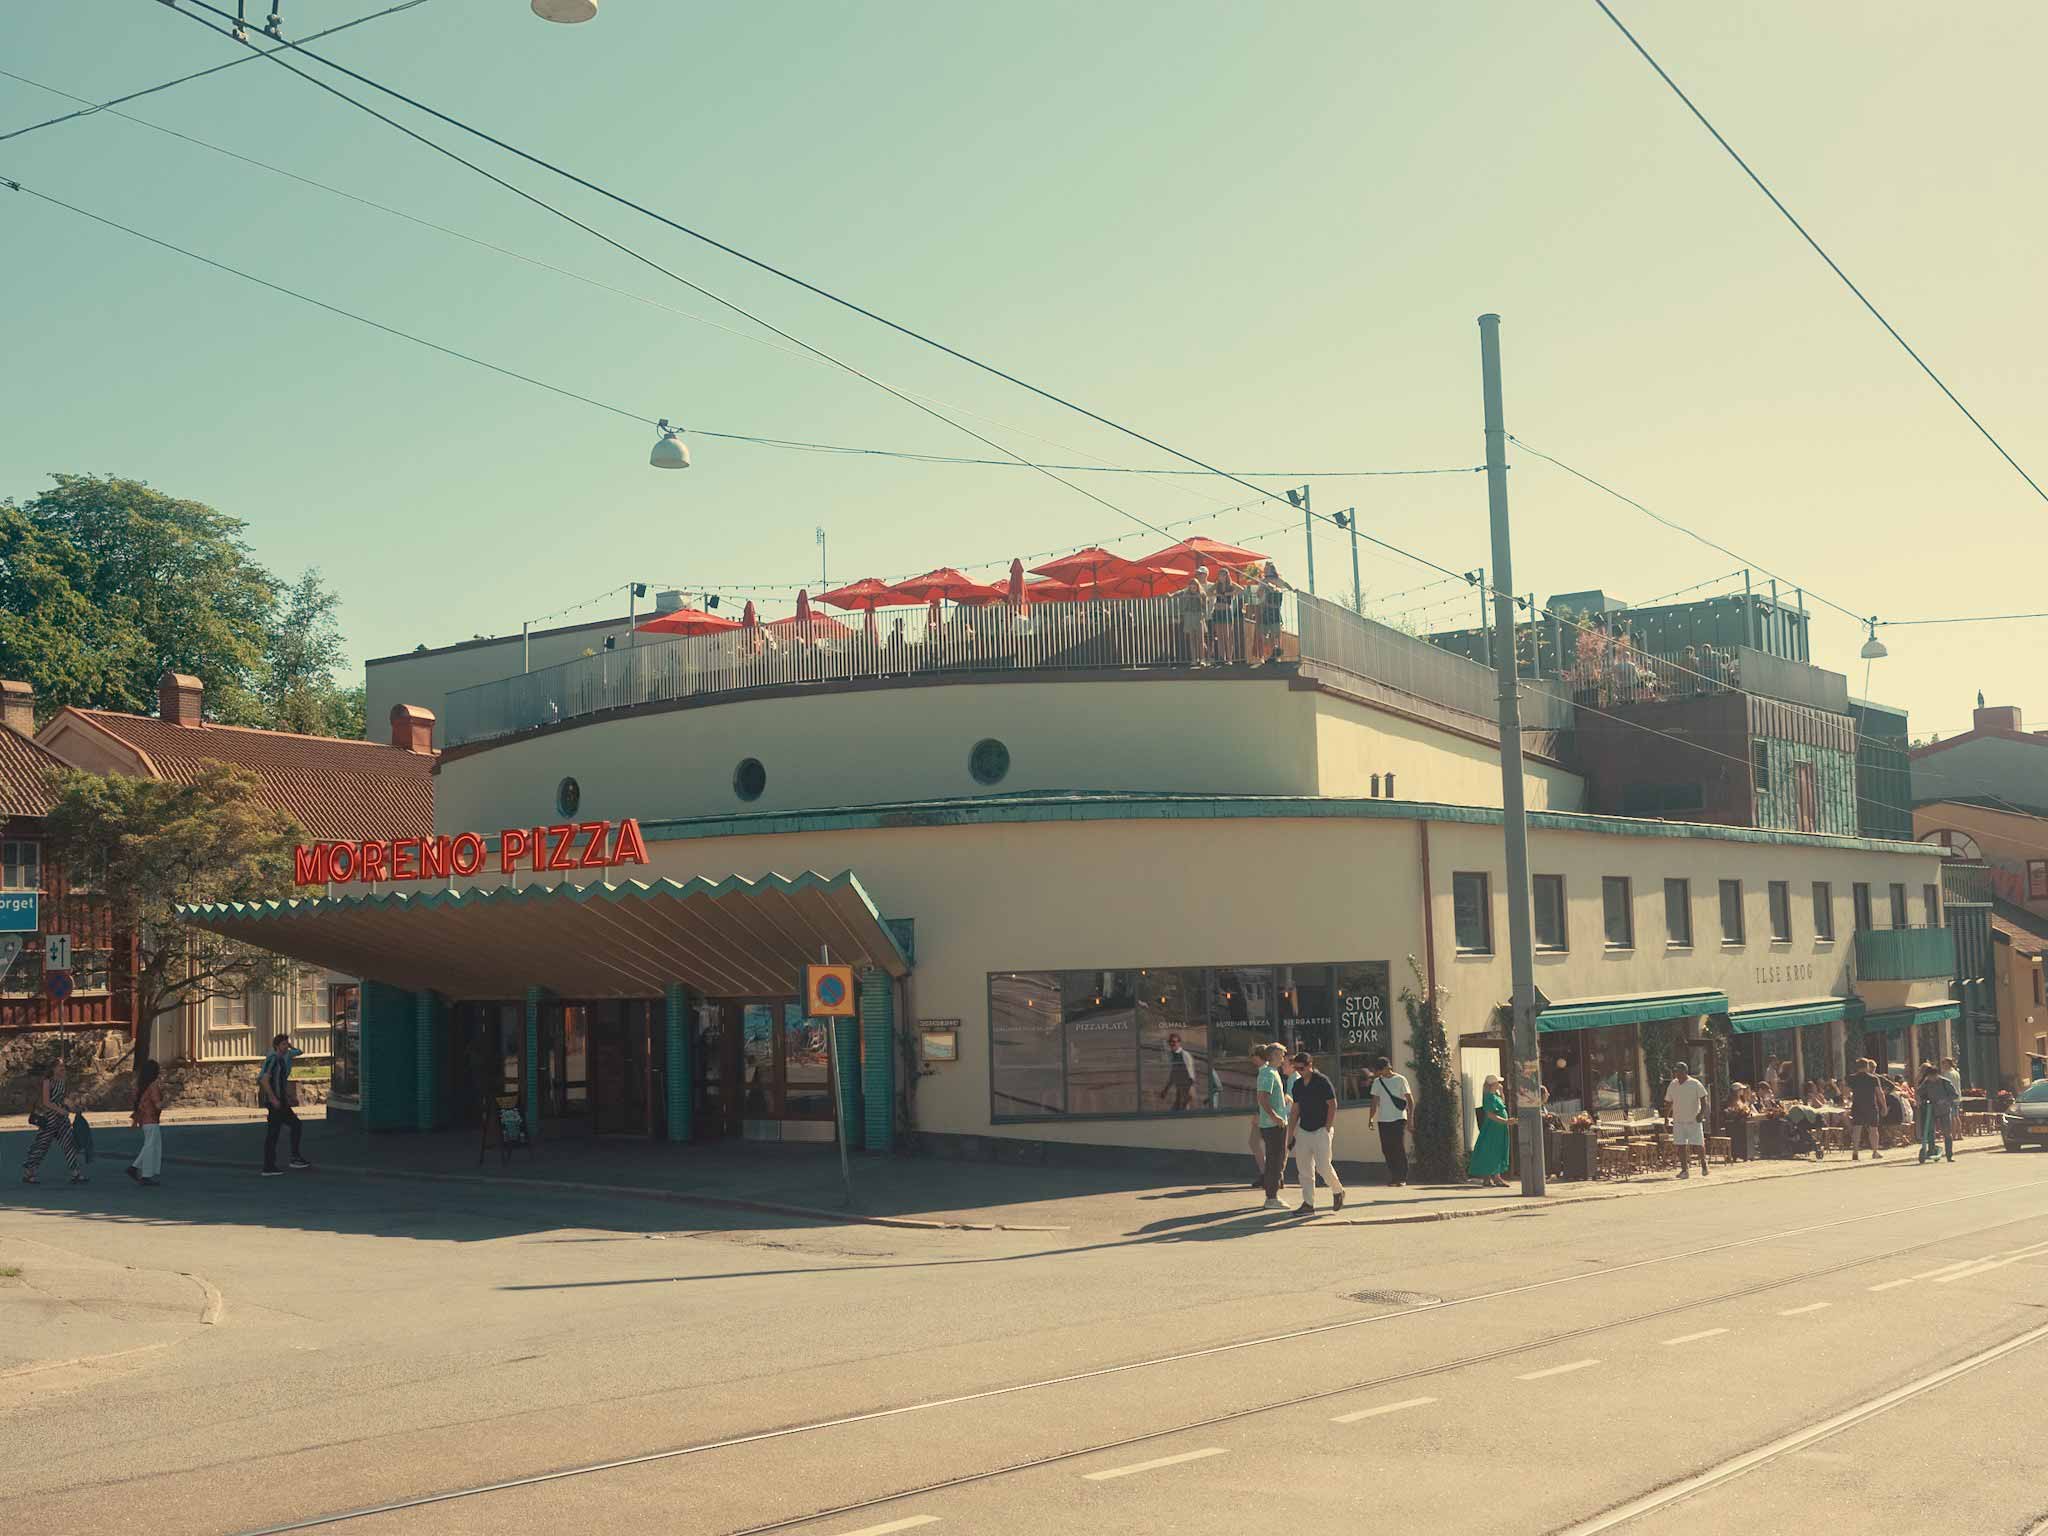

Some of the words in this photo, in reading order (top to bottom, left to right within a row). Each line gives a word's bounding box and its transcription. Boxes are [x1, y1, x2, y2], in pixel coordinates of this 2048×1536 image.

[295, 831, 488, 886] MORENO
[501, 818, 650, 874] PIZZA
[1756, 966, 1781, 984] ILSE
[1786, 963, 1813, 982] KROG
[1345, 995, 1380, 1011] STOR
[1341, 1010, 1384, 1028] STARK
[1348, 1029, 1378, 1044] 39KR
